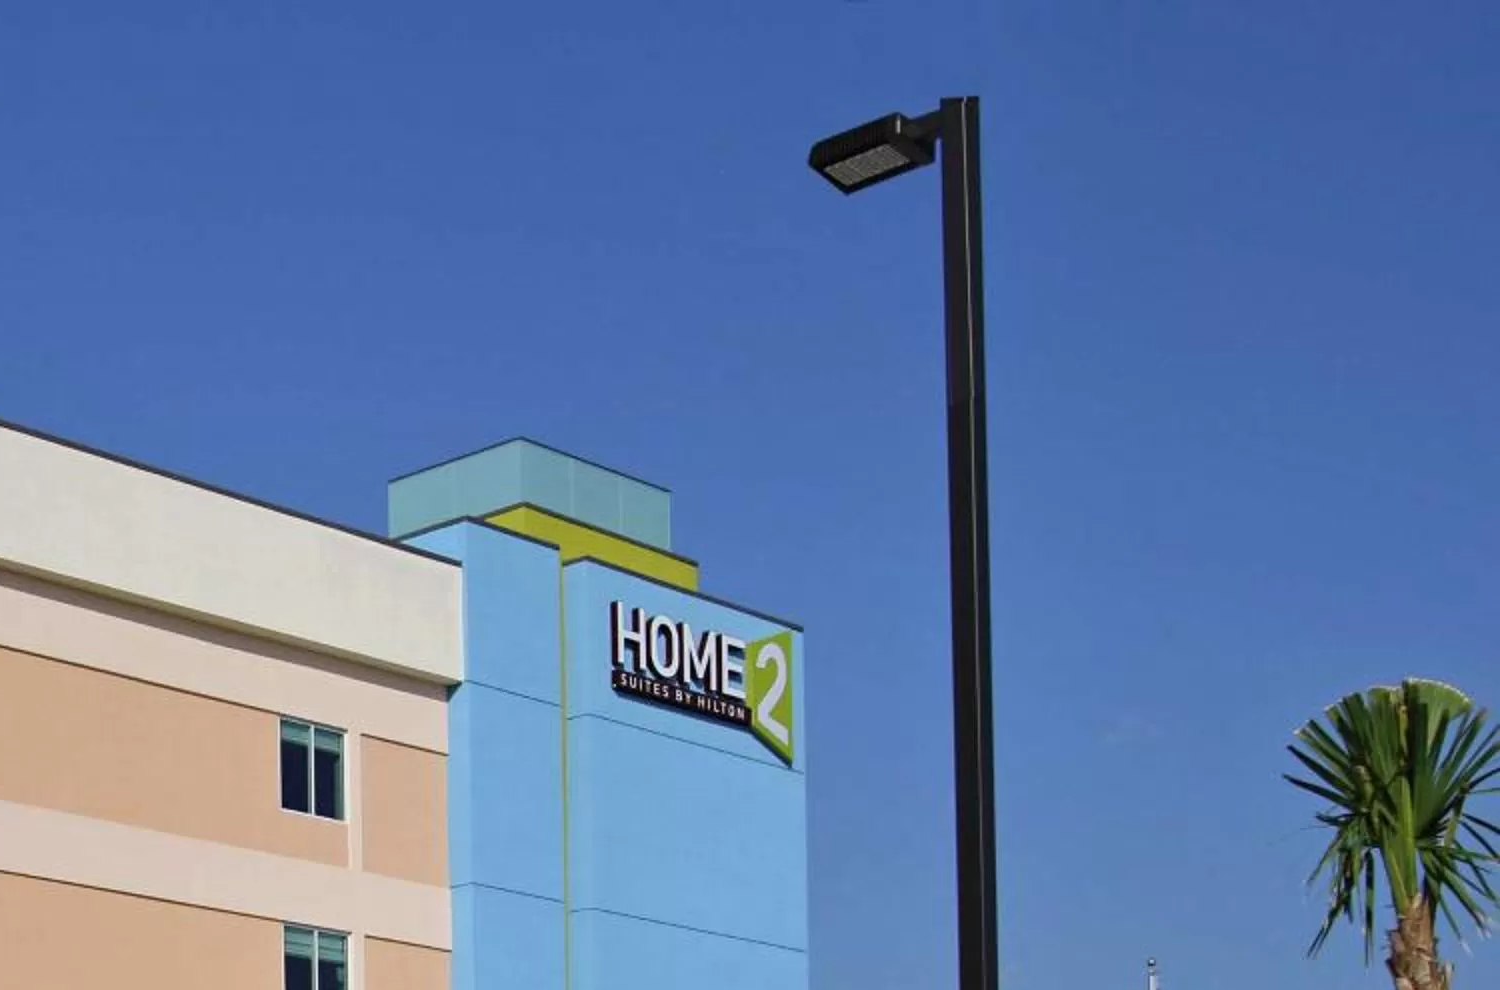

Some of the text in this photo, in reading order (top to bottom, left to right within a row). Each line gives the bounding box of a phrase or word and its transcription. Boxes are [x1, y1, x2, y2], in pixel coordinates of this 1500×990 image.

[612, 600, 788, 745] HOME 2
[620, 673, 745, 720] SUITES BY HILTON
